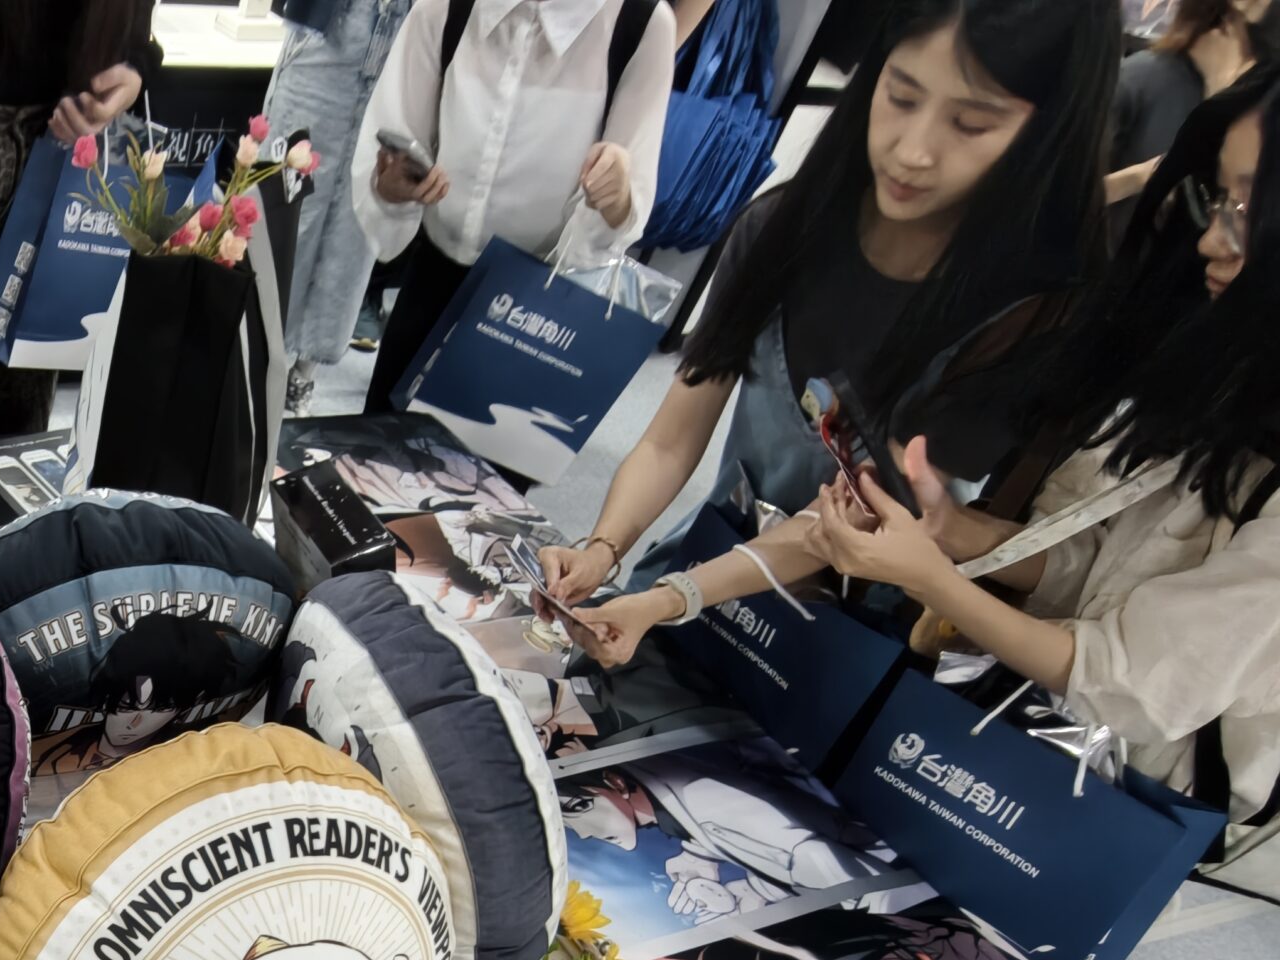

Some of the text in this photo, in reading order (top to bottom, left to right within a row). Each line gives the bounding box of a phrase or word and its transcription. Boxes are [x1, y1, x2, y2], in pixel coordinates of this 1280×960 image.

[18, 610, 89, 664] THE
[714, 600, 776, 648] 灣角川
[738, 643, 789, 691] CORPORATION
[873, 765, 1041, 879] KADOKAWA TAIWAN CORPORATION
[916, 753, 1026, 831] 台灣角川
[284, 817, 412, 883] READER'S
